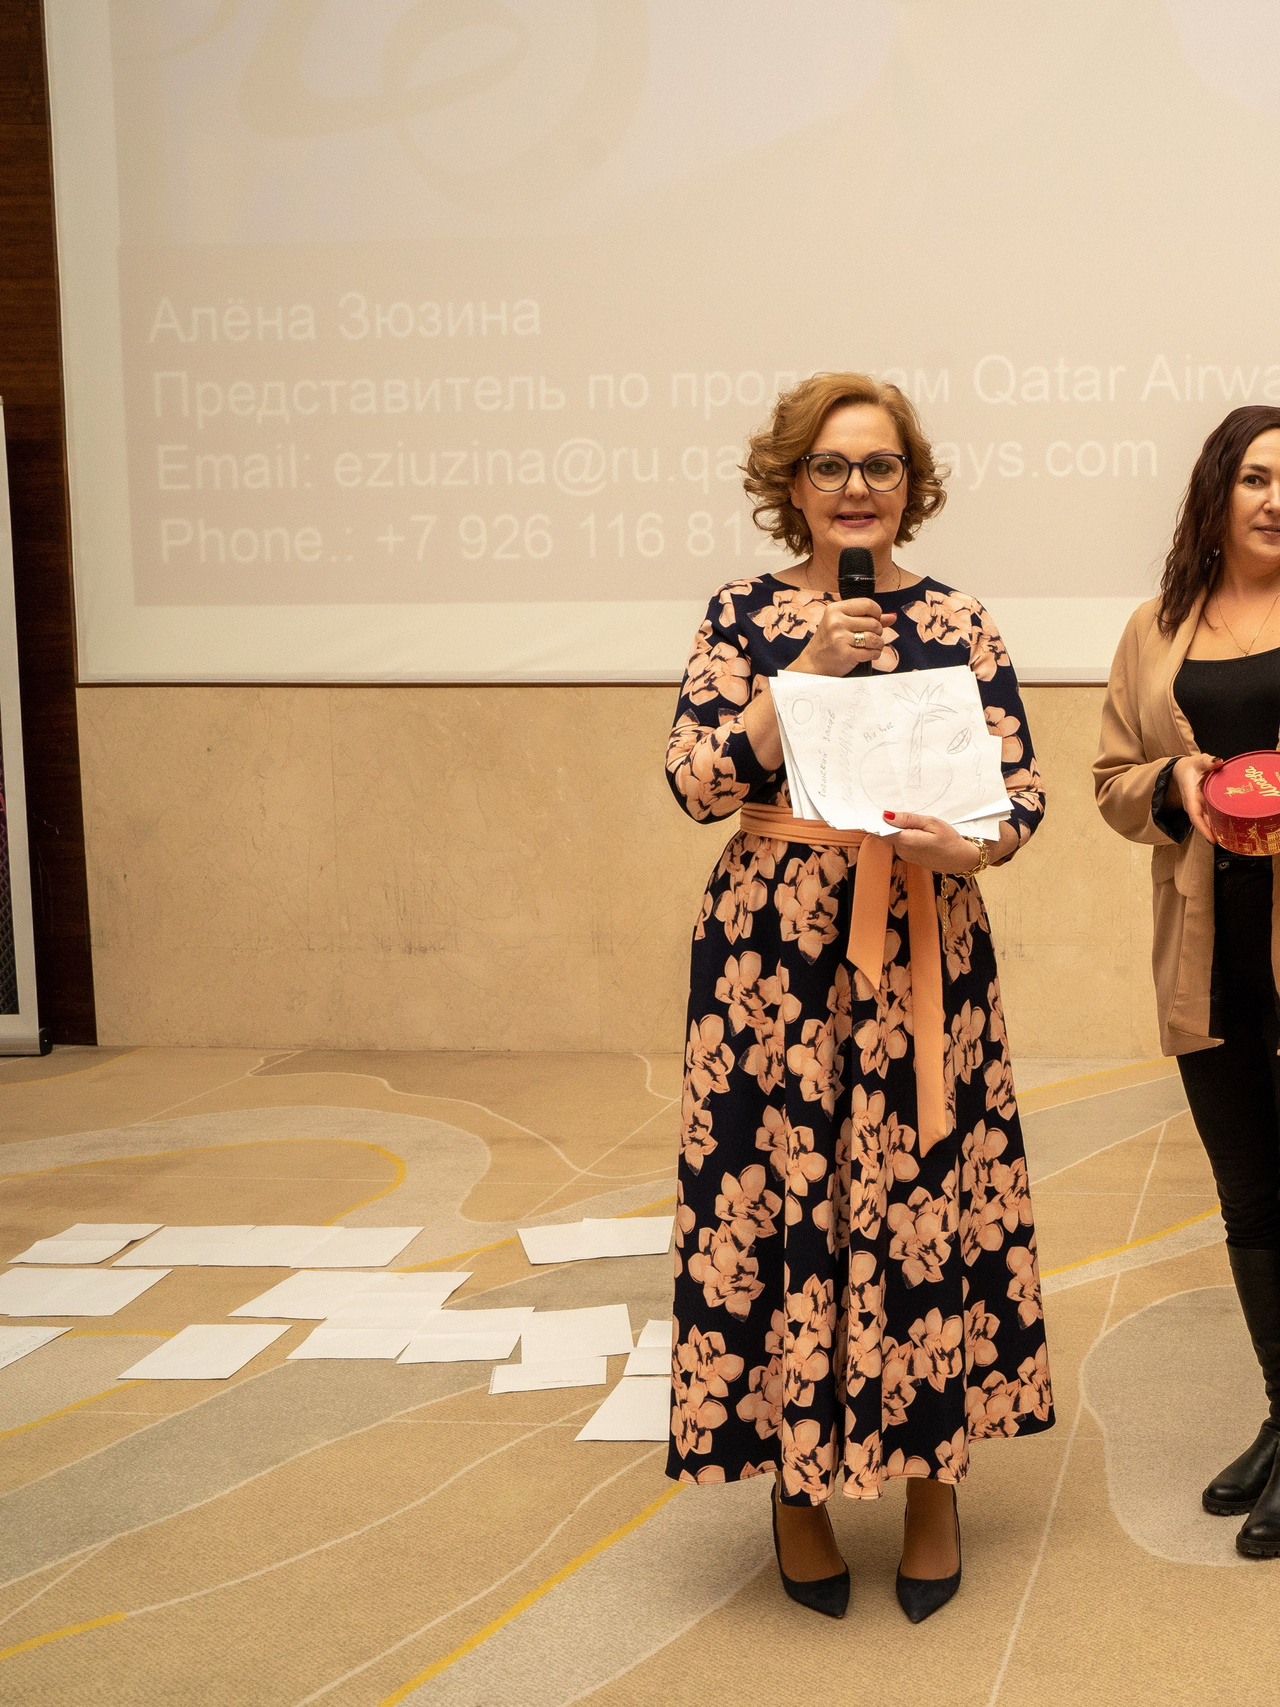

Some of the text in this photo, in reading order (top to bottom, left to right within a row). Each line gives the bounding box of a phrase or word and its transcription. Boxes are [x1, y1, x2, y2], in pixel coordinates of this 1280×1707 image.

[149, 291, 542, 343] Алёна Зюзина
[153, 370, 567, 429] Представитель
[587, 371, 650, 409] по
[973, 353, 1127, 405] Qatar
[157, 443, 313, 491] Email:
[160, 517, 354, 565] Phone.:
[376, 513, 438, 562] +7
[458, 512, 554, 560] 926
[578, 510, 666, 558] 116
